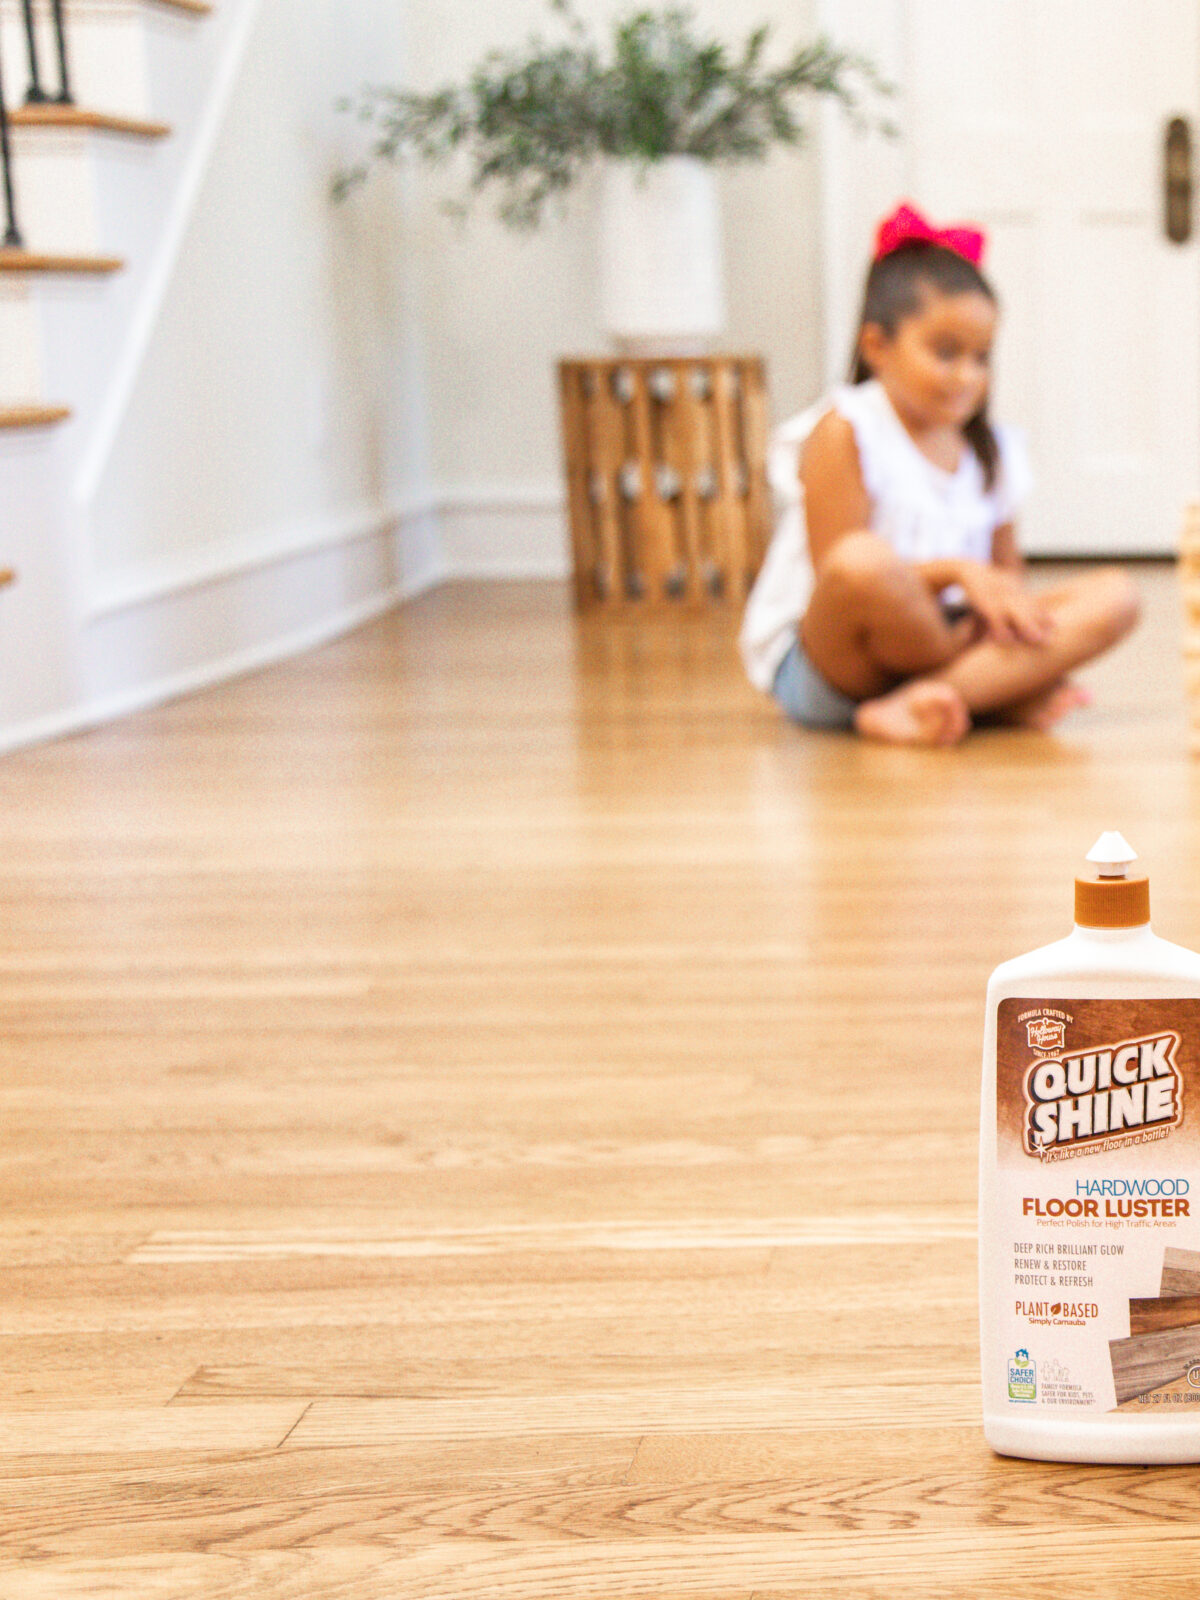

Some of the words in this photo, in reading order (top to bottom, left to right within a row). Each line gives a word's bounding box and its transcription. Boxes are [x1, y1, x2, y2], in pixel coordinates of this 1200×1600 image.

[1017, 1009, 1042, 1023] FORMULA
[1042, 1008, 1066, 1020] CRAFTED
[1031, 1036, 1173, 1102] QUICK
[1031, 1075, 1176, 1146] SHINE
[1046, 1149, 1058, 1163] It's
[1059, 1147, 1075, 1161] like
[1076, 1148, 1083, 1157] a
[1084, 1144, 1101, 1156] new
[1103, 1138, 1122, 1152] floor
[1124, 1135, 1133, 1147] in
[1134, 1136, 1141, 1145] a
[1142, 1127, 1170, 1143] bottle!
[1076, 1179, 1190, 1196] HARDWOOD
[1022, 1197, 1099, 1218] FLOOR
[1105, 1198, 1190, 1218] LUSTER
[1036, 1218, 1064, 1227] Perfect
[1066, 1219, 1090, 1228] Polish
[1091, 1219, 1103, 1228] for
[1105, 1219, 1124, 1230] High
[1126, 1220, 1151, 1228] Traffic
[1153, 1220, 1177, 1228] Areas
[1014, 1242, 1033, 1254] DEEP
[1035, 1243, 1054, 1255] RICH
[1057, 1243, 1098, 1256] BRILLIANT
[1100, 1244, 1125, 1256] GLOW
[1014, 1258, 1042, 1270] RENEW
[1044, 1260, 1050, 1270] &
[1052, 1260, 1087, 1271] RESTORE
[1014, 1274, 1048, 1286] PROTECT
[1050, 1276, 1056, 1286] &
[1059, 1276, 1094, 1288] REFRESH
[1015, 1301, 1050, 1317] PLANT
[1063, 1302, 1099, 1318] BASED
[1028, 1317, 1052, 1327] Simply
[1052, 1318, 1087, 1327] Carnauba
[1009, 1368, 1034, 1378] SAFER
[1009, 1376, 1034, 1385] CHOICE
